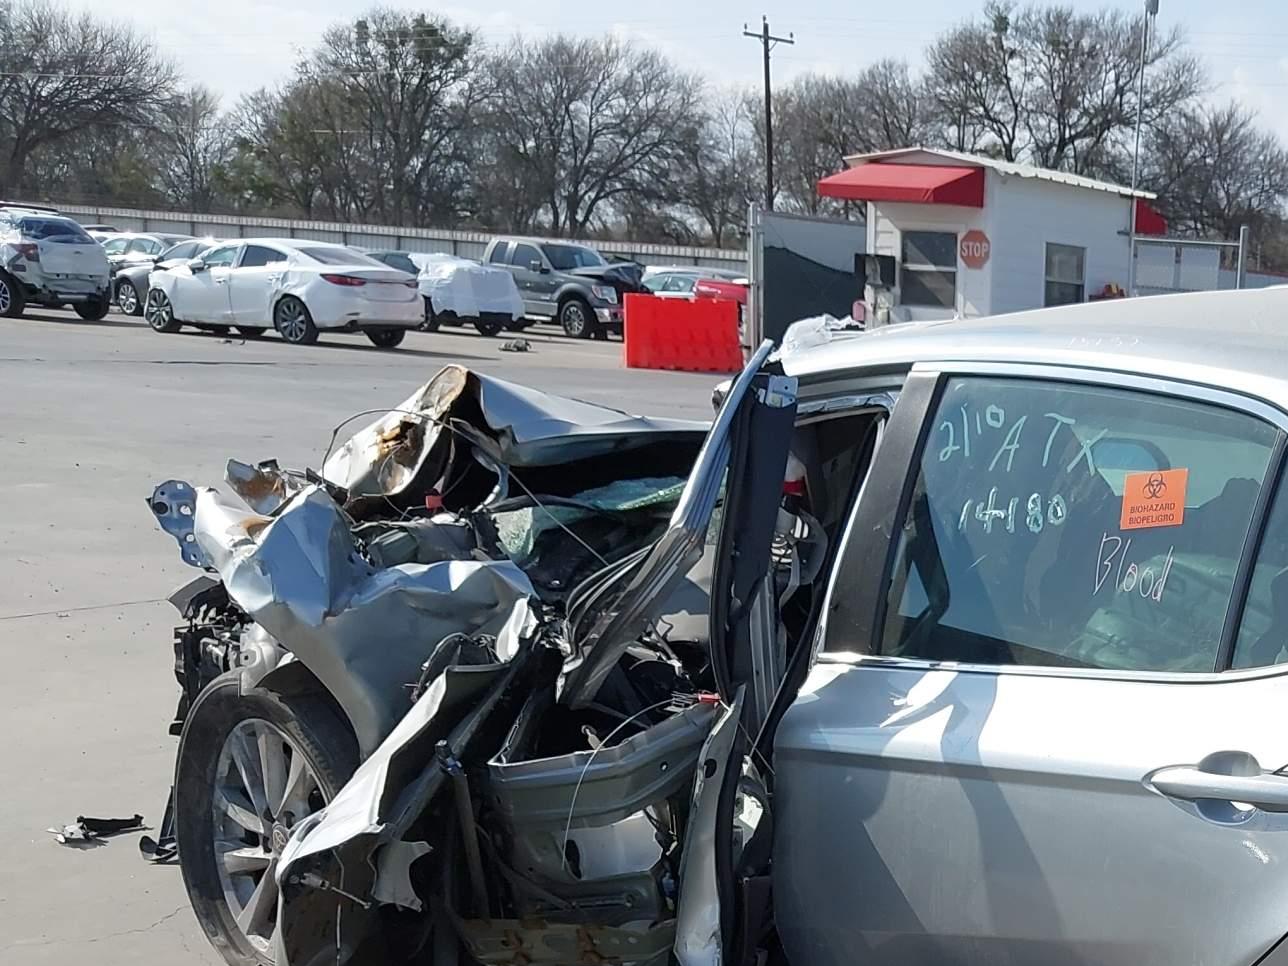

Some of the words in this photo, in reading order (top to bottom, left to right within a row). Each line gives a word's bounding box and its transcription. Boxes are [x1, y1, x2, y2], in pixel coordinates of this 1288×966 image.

[961, 241, 989, 258] STOP
[958, 486, 1067, 534] 14180
[1129, 502, 1176, 514] BIOHAZARD
[1128, 513, 1175, 525] BIOPELIGRO
[1092, 532, 1174, 602] Blood
